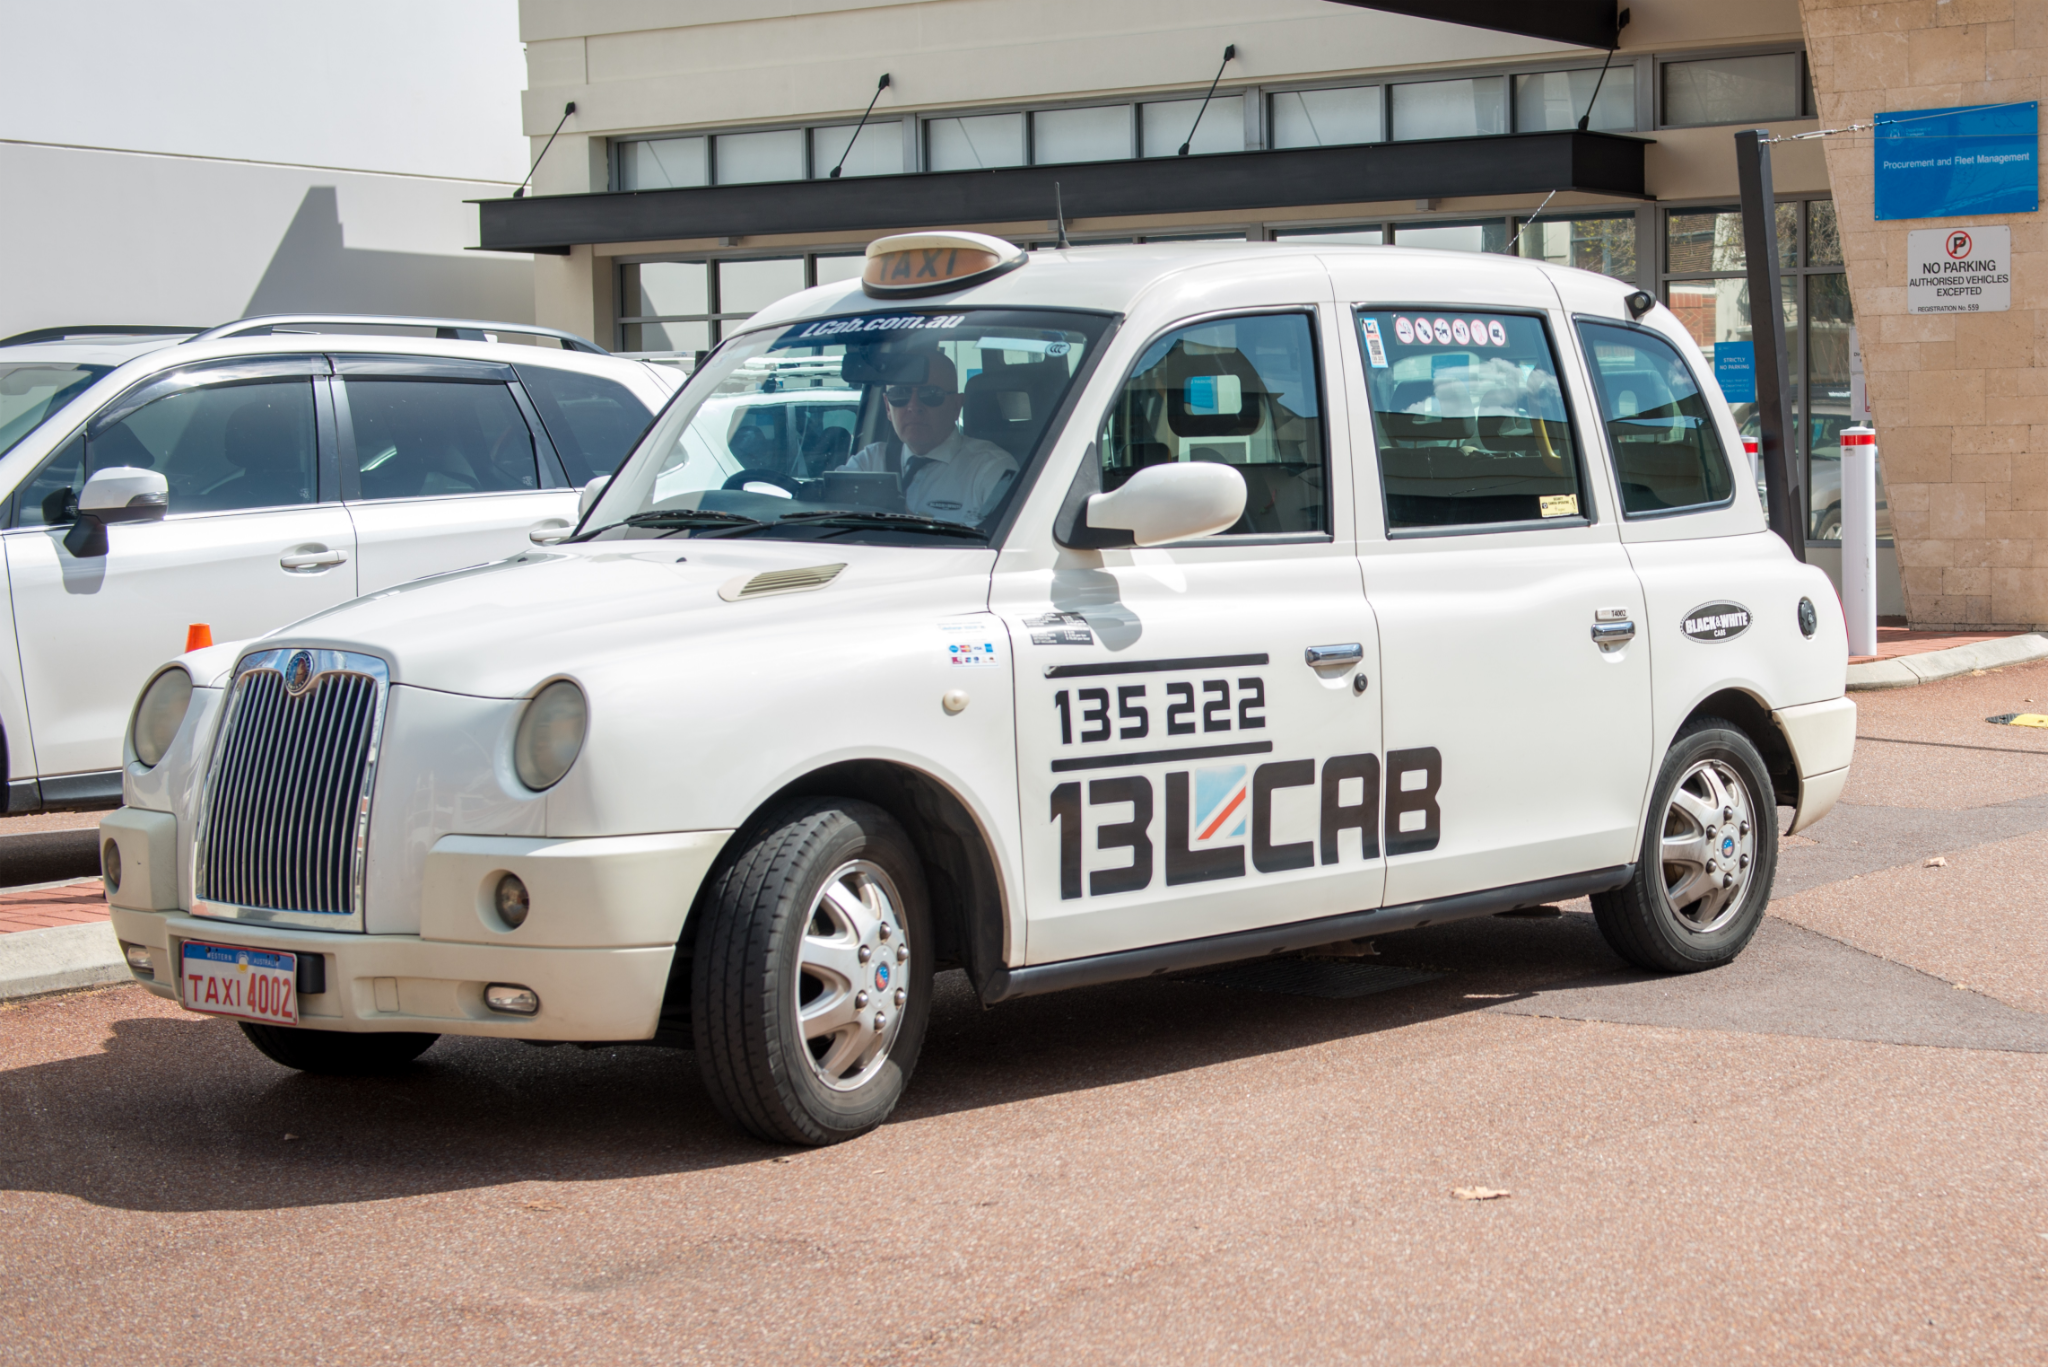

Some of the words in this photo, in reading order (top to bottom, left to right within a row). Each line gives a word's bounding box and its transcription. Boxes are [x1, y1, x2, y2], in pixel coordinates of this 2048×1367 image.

[1883, 158, 1934, 170] Procurement
[1937, 157, 1951, 166] and
[1954, 155, 1974, 165] Fleet
[1977, 152, 2030, 165] Management
[879, 249, 958, 282] TAXI
[1922, 262, 1941, 274] NO
[1944, 259, 1996, 273] PARKING
[1909, 276, 1964, 287] AUTHORISED
[1966, 274, 2009, 285] VEHICLES
[1936, 286, 1982, 297] EXCEPTED
[1967, 303, 1979, 311] 559
[799, 315, 966, 338] LCab.com.au
[1685, 612, 1748, 634] BLACK&WHITE
[1055, 685, 1149, 744] 135
[1166, 677, 1266, 736] 222
[206, 952, 232, 961] WESTERN
[253, 958, 280, 967] AUSTRALIA
[188, 974, 241, 1007] TAXI
[247, 973, 293, 1018] 4002
